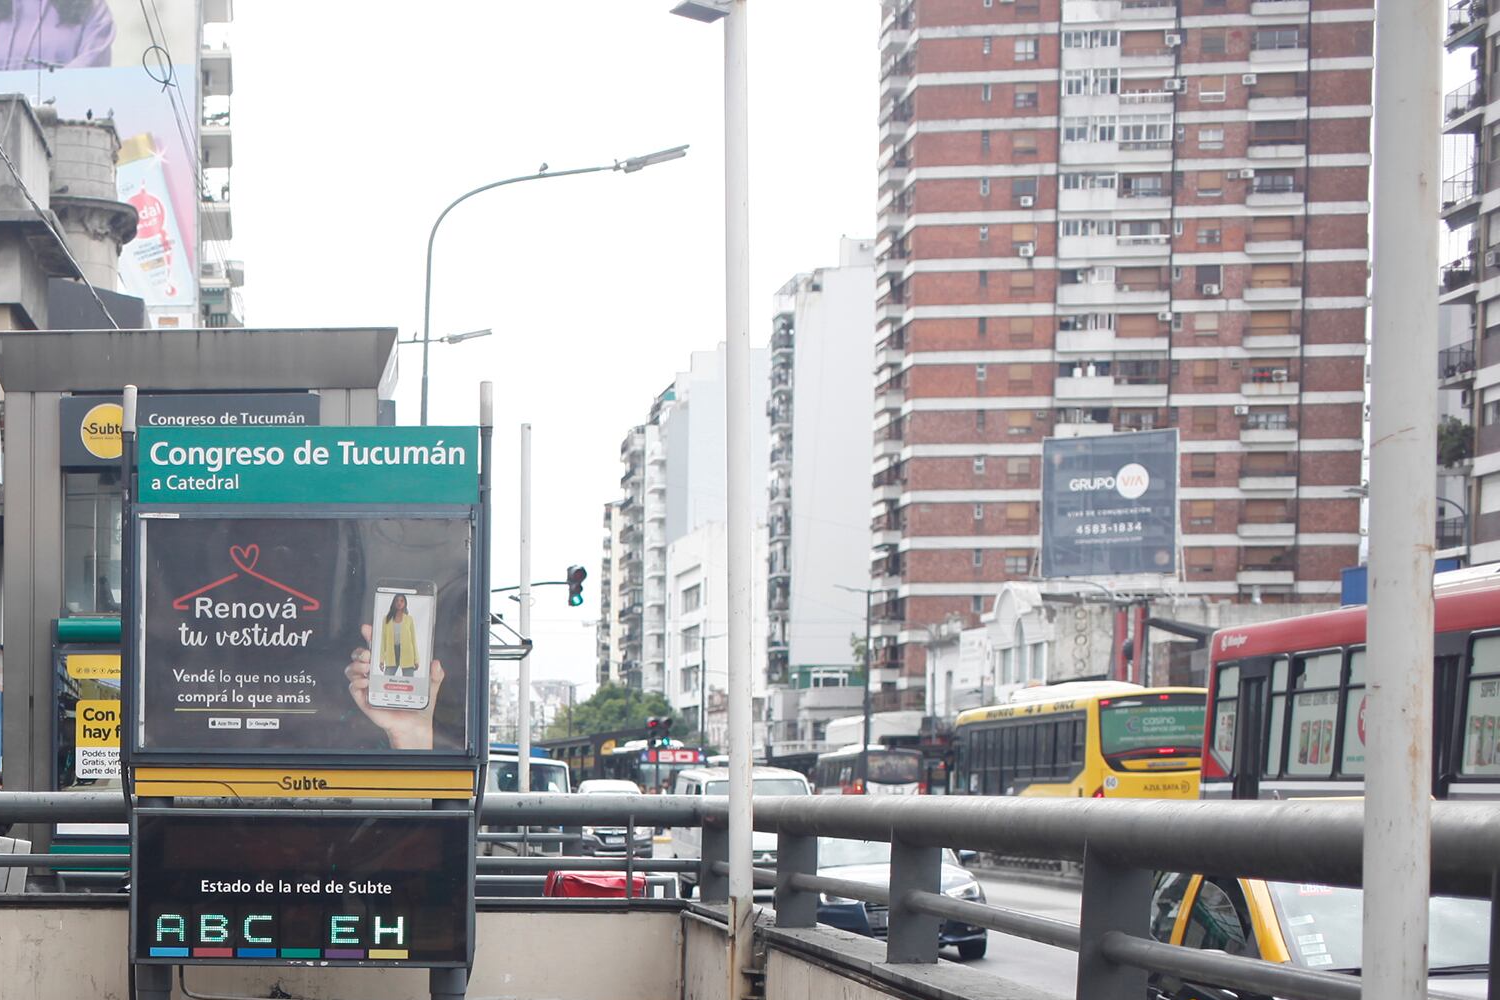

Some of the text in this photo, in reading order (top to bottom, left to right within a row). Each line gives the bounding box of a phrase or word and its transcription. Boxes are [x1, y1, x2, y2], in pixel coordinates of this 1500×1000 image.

[148, 411, 305, 426] Congreso de Tucumán
[150, 439, 466, 472] Congreso de Tucumán
[151, 473, 240, 491] a Catedral
[1069, 476, 1115, 492] GRUPO
[195, 597, 297, 619] Renová
[178, 623, 313, 647] tu vestidor
[172, 669, 316, 688] Vendé lo que no usás,
[177, 689, 311, 708] comprá lo que amás
[83, 707, 115, 722] Con
[1143, 716, 1175, 724] casino
[83, 724, 111, 741] hay
[82, 758, 106, 767] Gratis,
[82, 767, 102, 775] parte
[282, 775, 327, 790] Subte
[201, 879, 392, 895] Estado de la red de Subte
[156, 914, 404, 944] A B C E H
